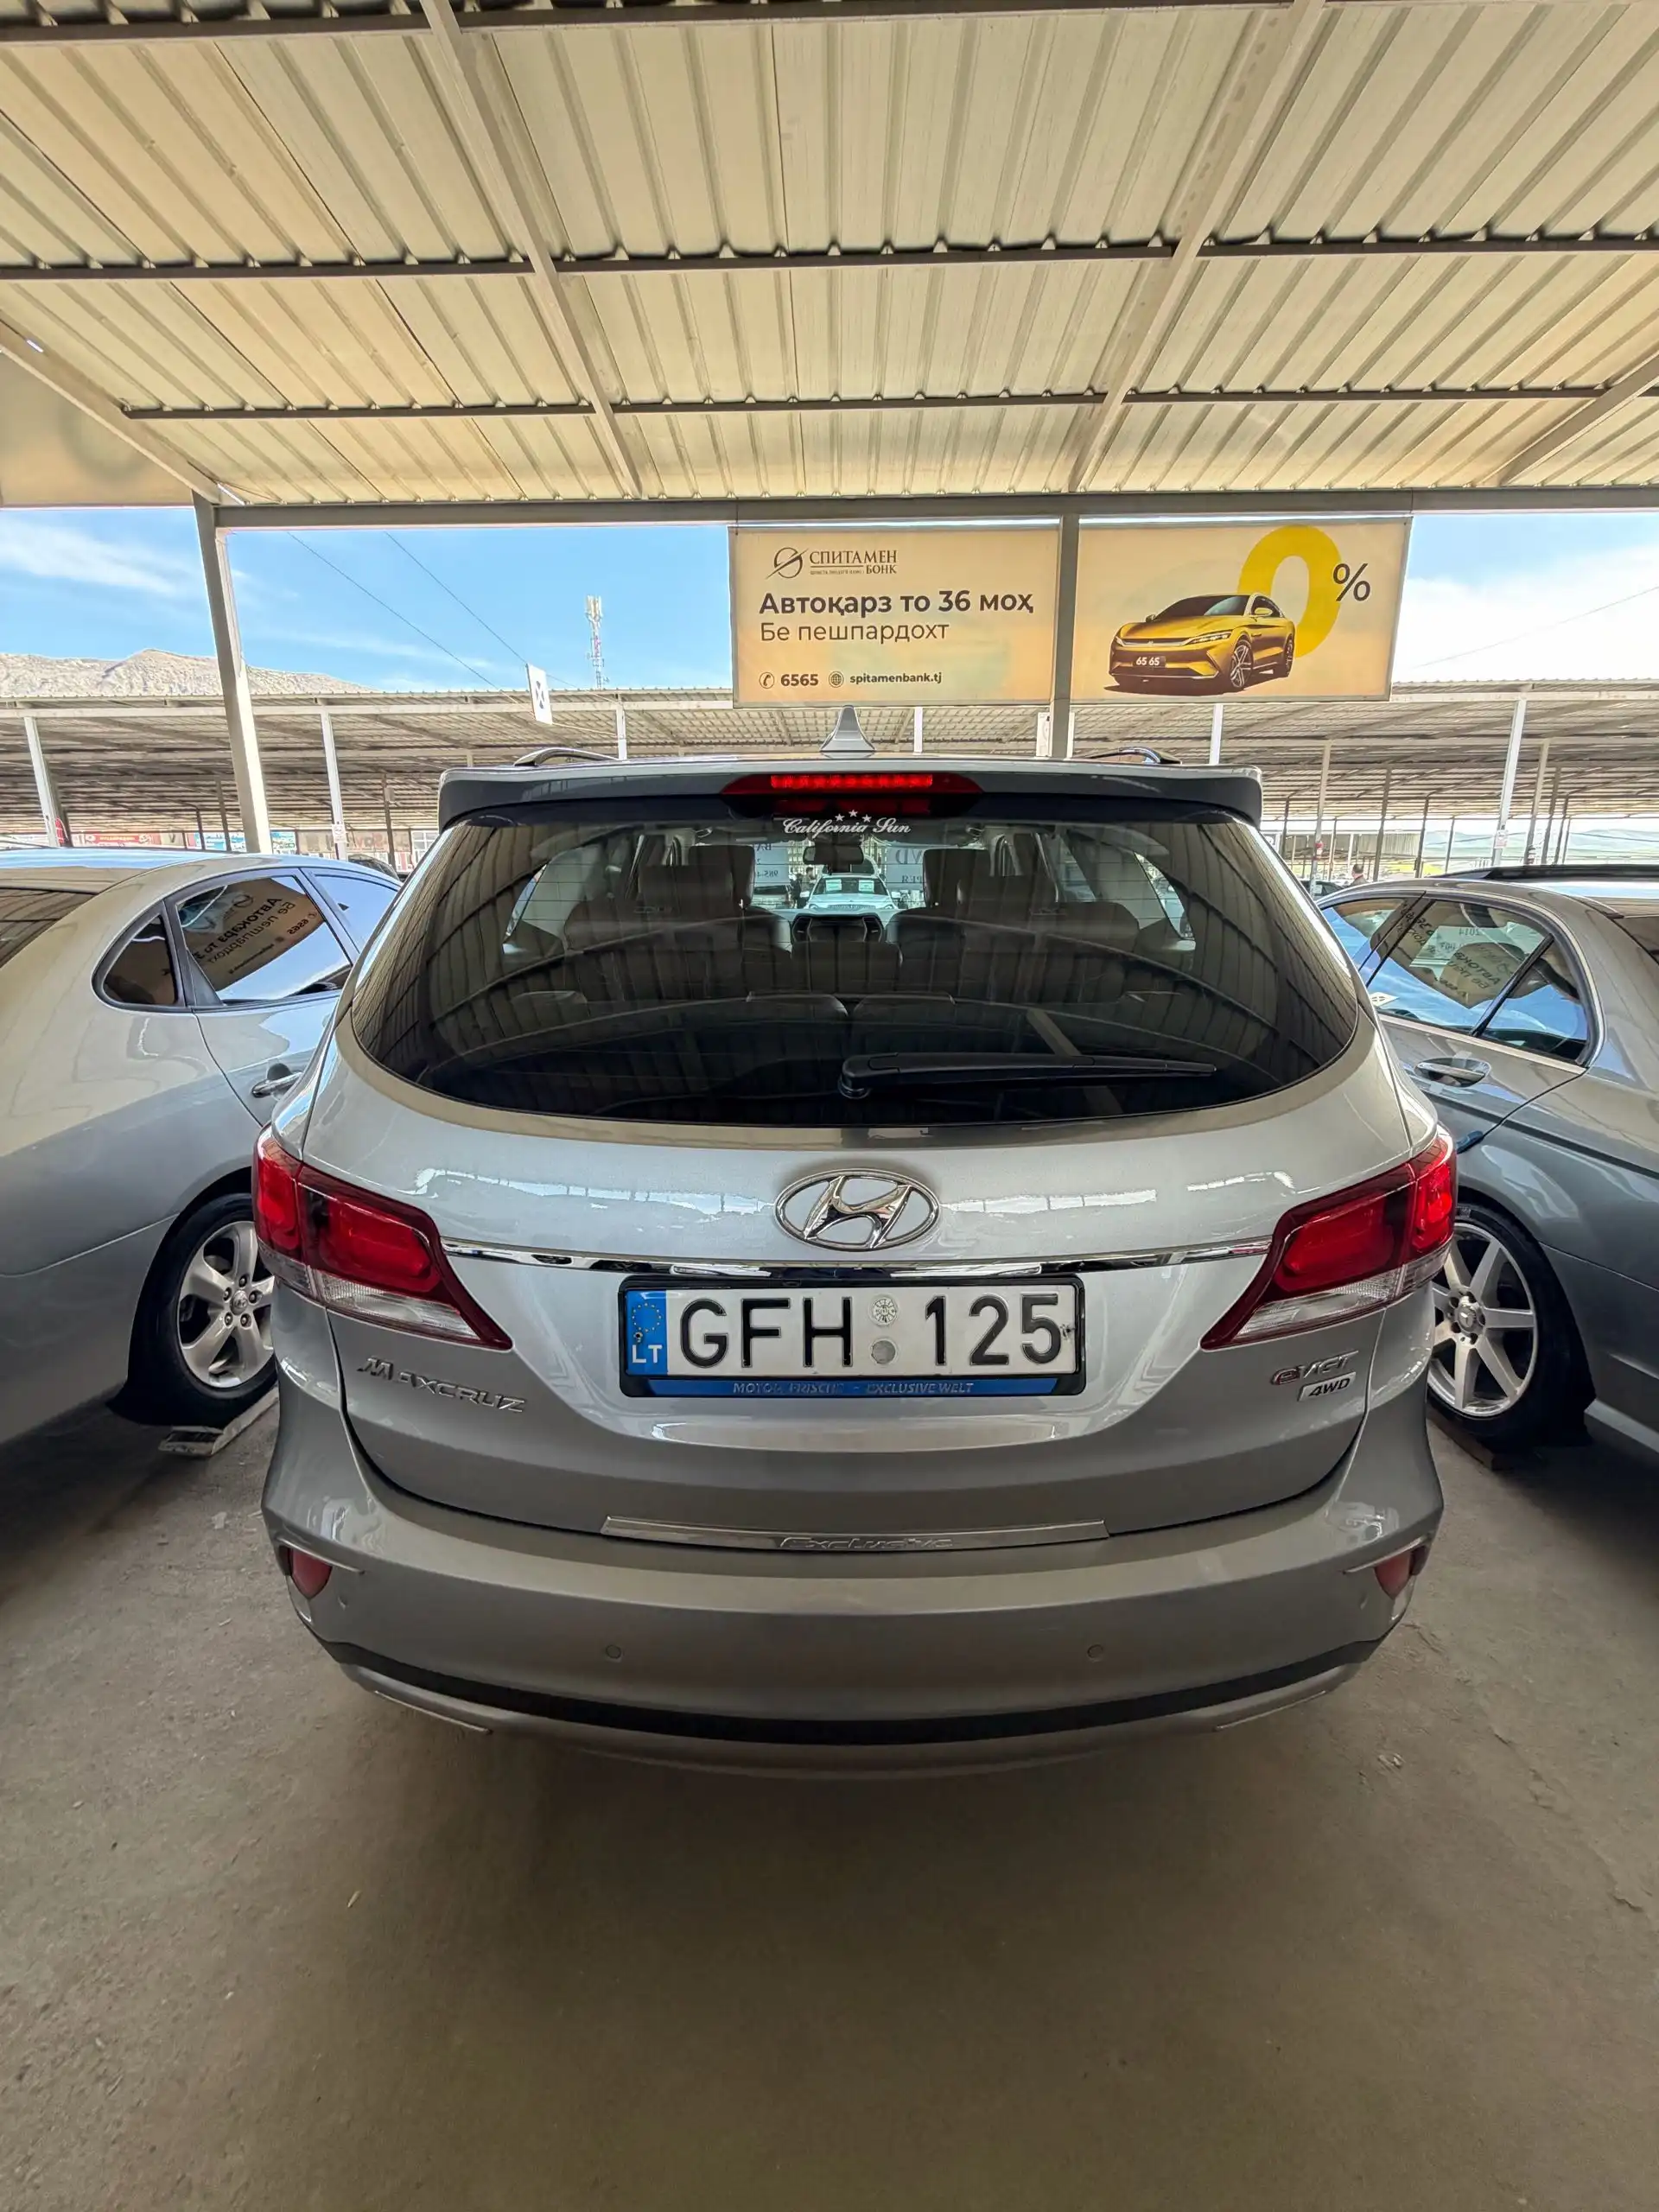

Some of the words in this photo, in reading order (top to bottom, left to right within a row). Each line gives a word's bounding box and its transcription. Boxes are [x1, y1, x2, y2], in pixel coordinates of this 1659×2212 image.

[809, 550, 897, 564] СПИТАМЕН
[866, 564, 897, 575] БОНК
[759, 592, 893, 618] Автоқарз
[900, 594, 931, 612] то
[938, 590, 971, 612] 36
[979, 594, 1034, 613] моҳ
[760, 622, 790, 641] Бе
[798, 623, 950, 644] пешпардохт
[1135, 656, 1147, 666] 65
[1148, 656, 1160, 666] 65
[780, 673, 819, 686] 6565
[849, 671, 943, 683] spitamenbank.tj
[782, 818, 868, 839] California
[872, 817, 912, 833] Sun
[680, 1297, 854, 1368] GFH
[925, 1293, 1063, 1366] 125
[632, 1344, 662, 1364] LT
[357, 1356, 525, 1413] MAXCRUZ
[936, 1382, 975, 1393] WELT
[1308, 1377, 1351, 1397] 4WD
